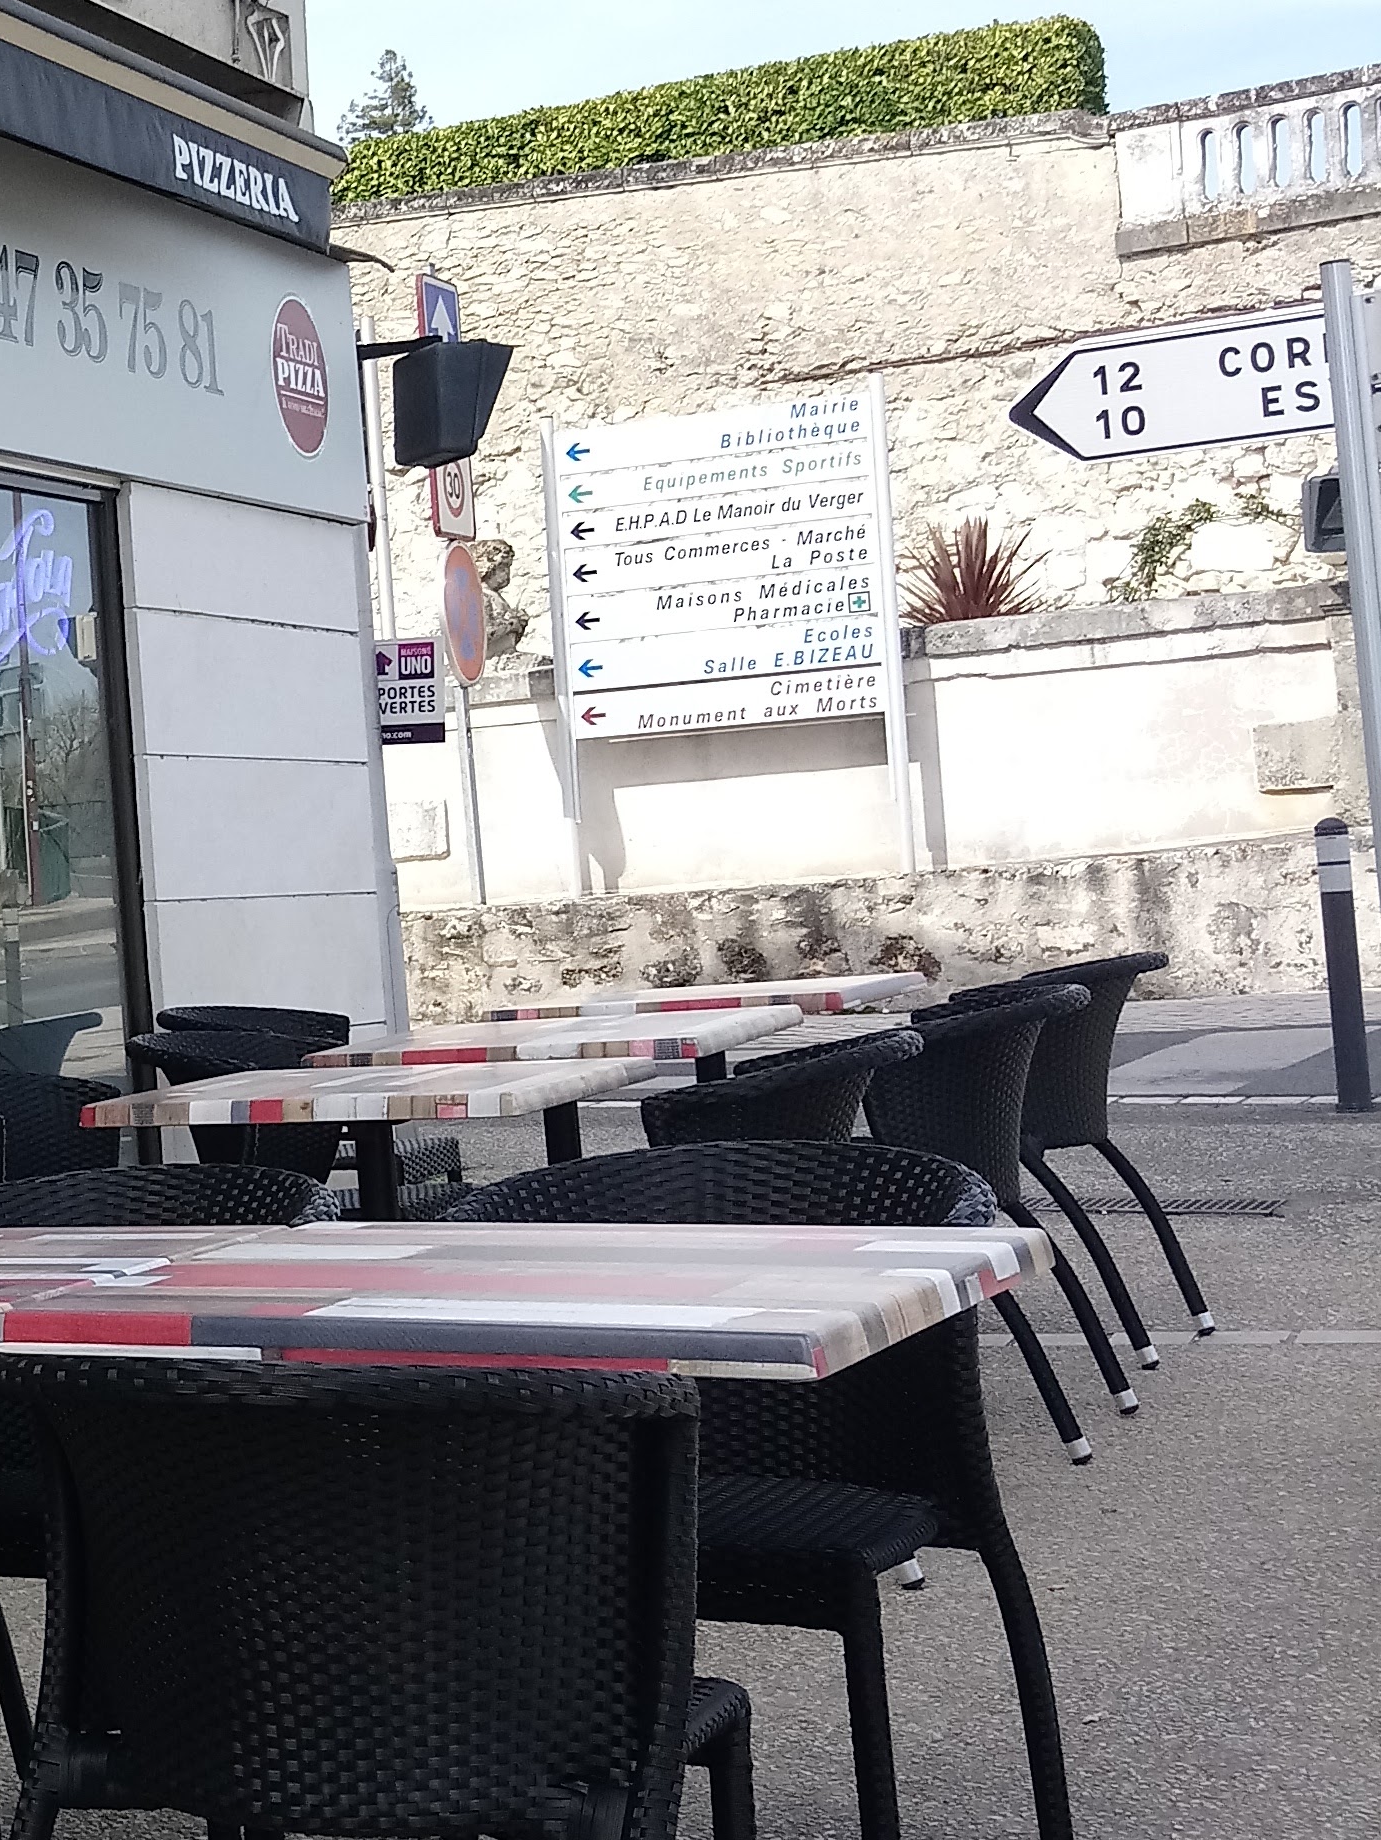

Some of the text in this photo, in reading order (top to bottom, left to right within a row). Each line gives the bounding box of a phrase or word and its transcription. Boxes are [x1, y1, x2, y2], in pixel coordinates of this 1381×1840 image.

[173, 132, 299, 224] PIZZERIA
[55, 260, 107, 363] 35
[119, 281, 167, 379] 75
[178, 299, 224, 396] 81
[277, 323, 319, 366] TRADI
[276, 358, 325, 397] PIZZA
[1093, 334, 1328, 396] 12 COR
[790, 399, 859, 419] Mairie
[1095, 379, 1331, 439] 10 ES
[721, 421, 859, 448] Bibliothèque
[447, 471, 460, 499] 30
[644, 452, 862, 492] Equipements Sportifs
[694, 508, 711, 522] Le
[718, 501, 775, 520] Manoir
[781, 497, 800, 512] du
[809, 491, 863, 510] Verger
[615, 551, 653, 567] Tous
[664, 537, 770, 560] Commerces
[797, 524, 866, 546] Marché
[772, 547, 868, 569] La Poste
[657, 575, 869, 610] Maisons Médicales
[734, 599, 844, 622] Pharmacie
[804, 625, 872, 643] Ecoles
[401, 647, 431, 655] MAISONS
[401, 656, 431, 674] UNO
[704, 644, 874, 674] Salle E.BIZEAU
[379, 685, 435, 700] PORTES
[771, 675, 876, 696] Cimetière
[638, 695, 877, 730] Monument aux Morts
